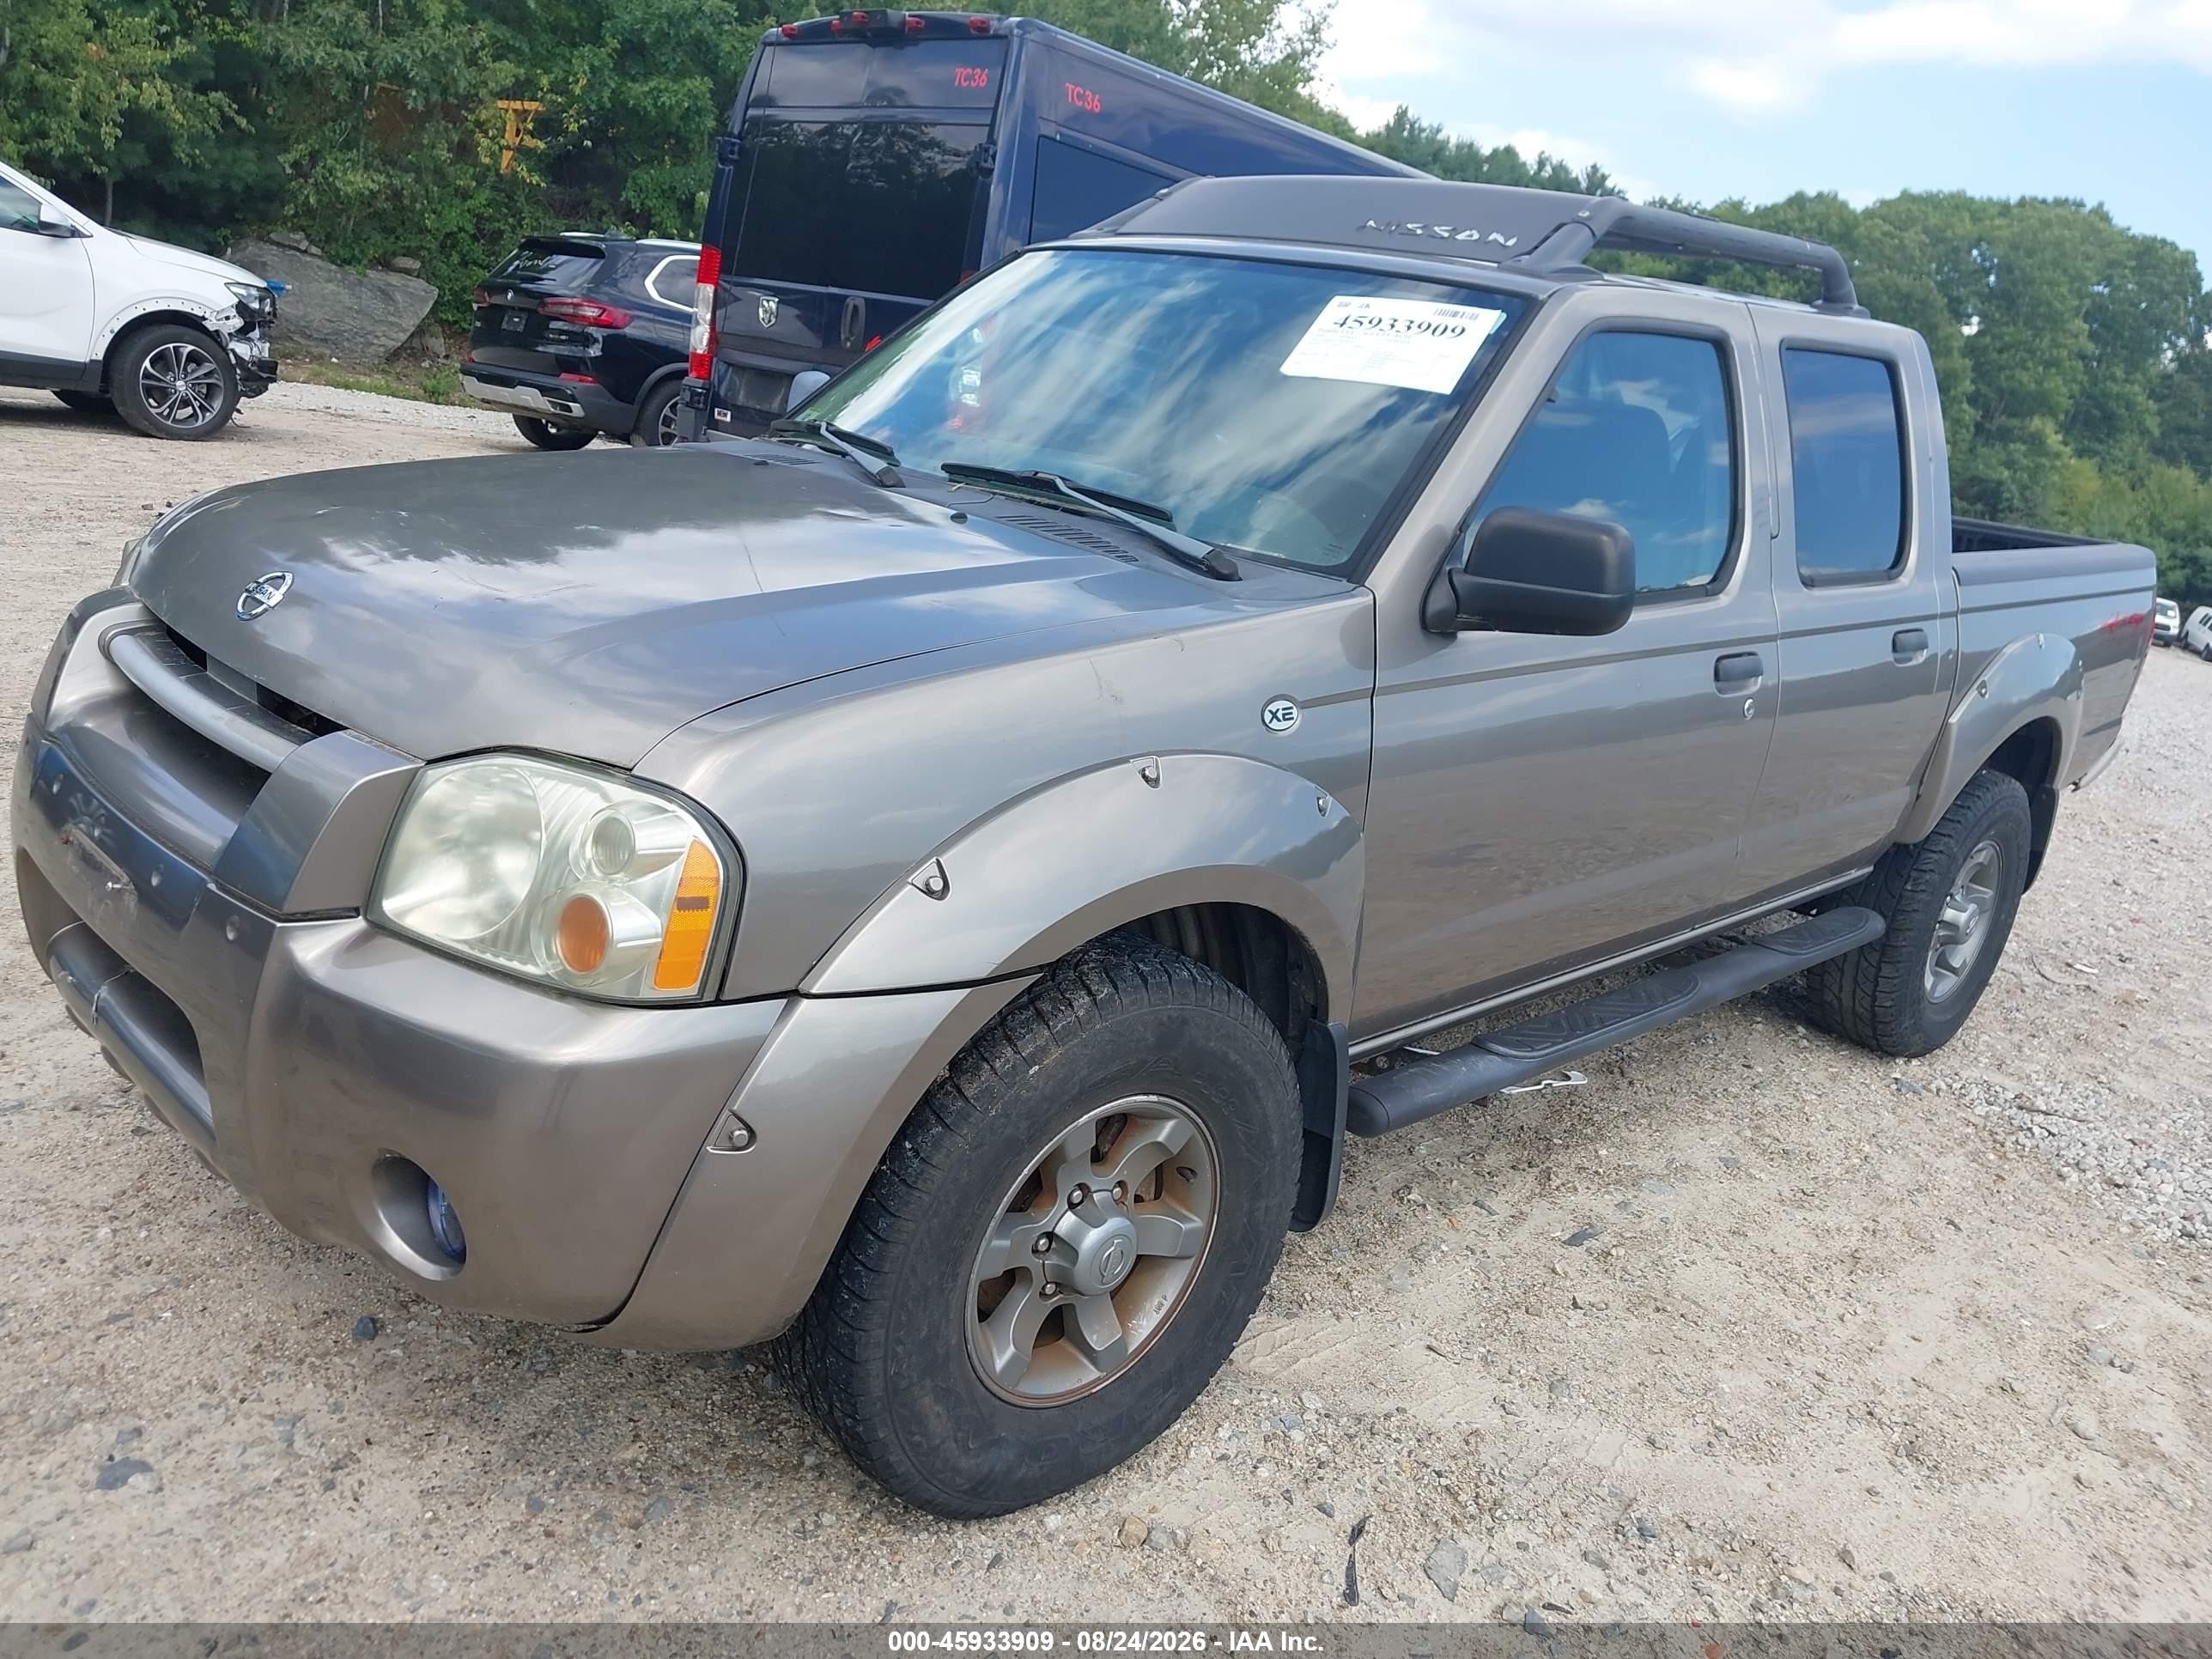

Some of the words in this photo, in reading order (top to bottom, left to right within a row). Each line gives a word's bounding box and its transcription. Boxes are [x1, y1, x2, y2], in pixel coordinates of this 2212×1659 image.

[954, 67, 988, 88] TC36
[1064, 82, 1101, 113] TC36
[1355, 218, 1518, 247] NISSAN
[1333, 313, 1467, 338] 45933909
[1267, 706, 1295, 724] XE
